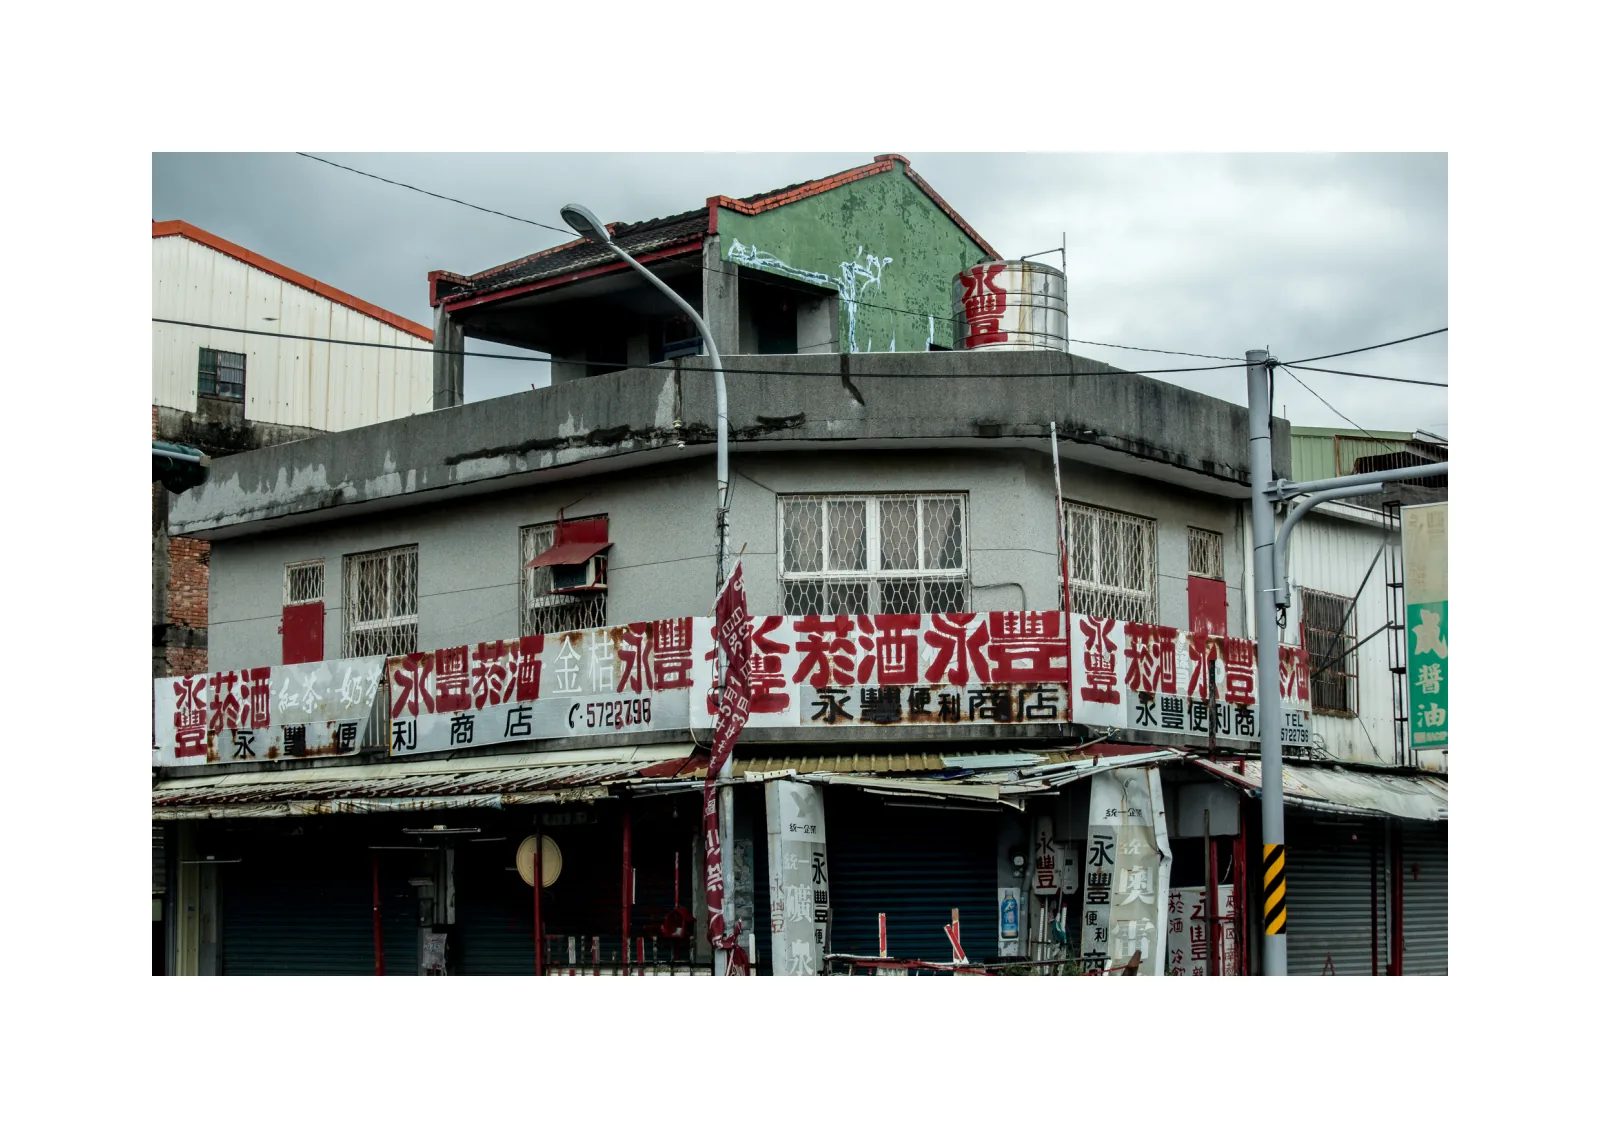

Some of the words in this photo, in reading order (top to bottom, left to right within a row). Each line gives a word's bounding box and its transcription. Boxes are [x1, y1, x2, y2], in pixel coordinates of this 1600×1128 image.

[960, 264, 1008, 350] 永豐
[617, 616, 694, 694] 永豐
[1080, 615, 1121, 704] 永豐
[174, 674, 208, 758] 永豐
[811, 686, 1059, 723] 永豐便利商店
[1136, 691, 1262, 738] 永豐便利商
[1285, 714, 1303, 727] TEL
[789, 823, 817, 834] 統一企業
[1105, 807, 1143, 817] 統一企業
[1036, 832, 1057, 889] 永豐
